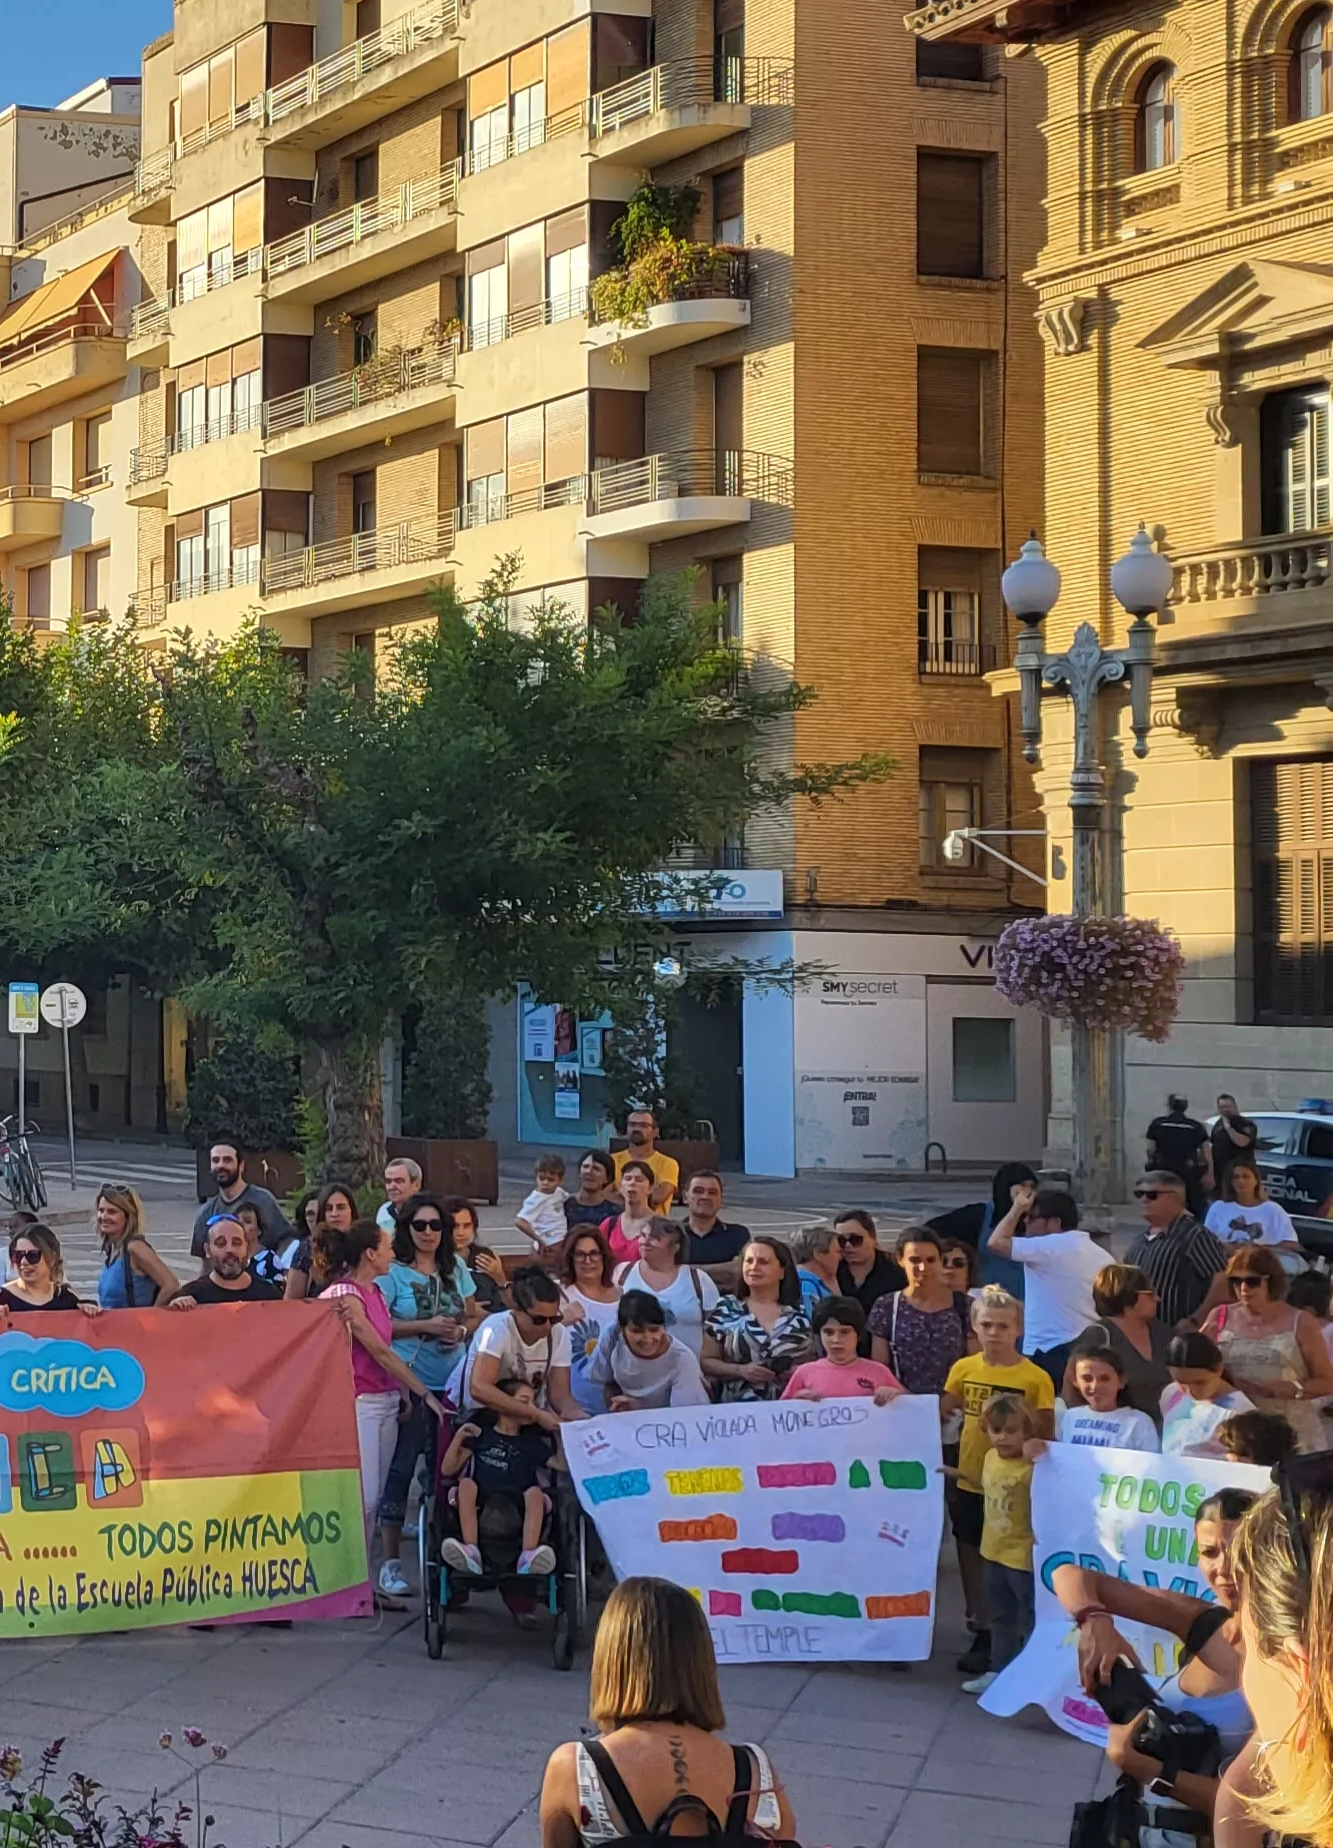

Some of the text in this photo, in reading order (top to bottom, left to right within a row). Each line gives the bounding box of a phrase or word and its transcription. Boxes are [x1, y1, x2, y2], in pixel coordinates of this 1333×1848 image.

[11, 1362, 116, 1394] CRÍTICA
[635, 1421, 688, 1449] CRA
[1099, 1472, 1205, 1518] TODOS
[98, 1519, 194, 1561] TODOS
[204, 1510, 342, 1554] PINTAMOS
[16, 1575, 41, 1616] de
[48, 1574, 68, 1615] la
[76, 1570, 153, 1613] Escuela
[161, 1563, 233, 1607] Pública
[242, 1556, 320, 1599] HUESCA
[735, 1623, 824, 1654] TEMPLE
